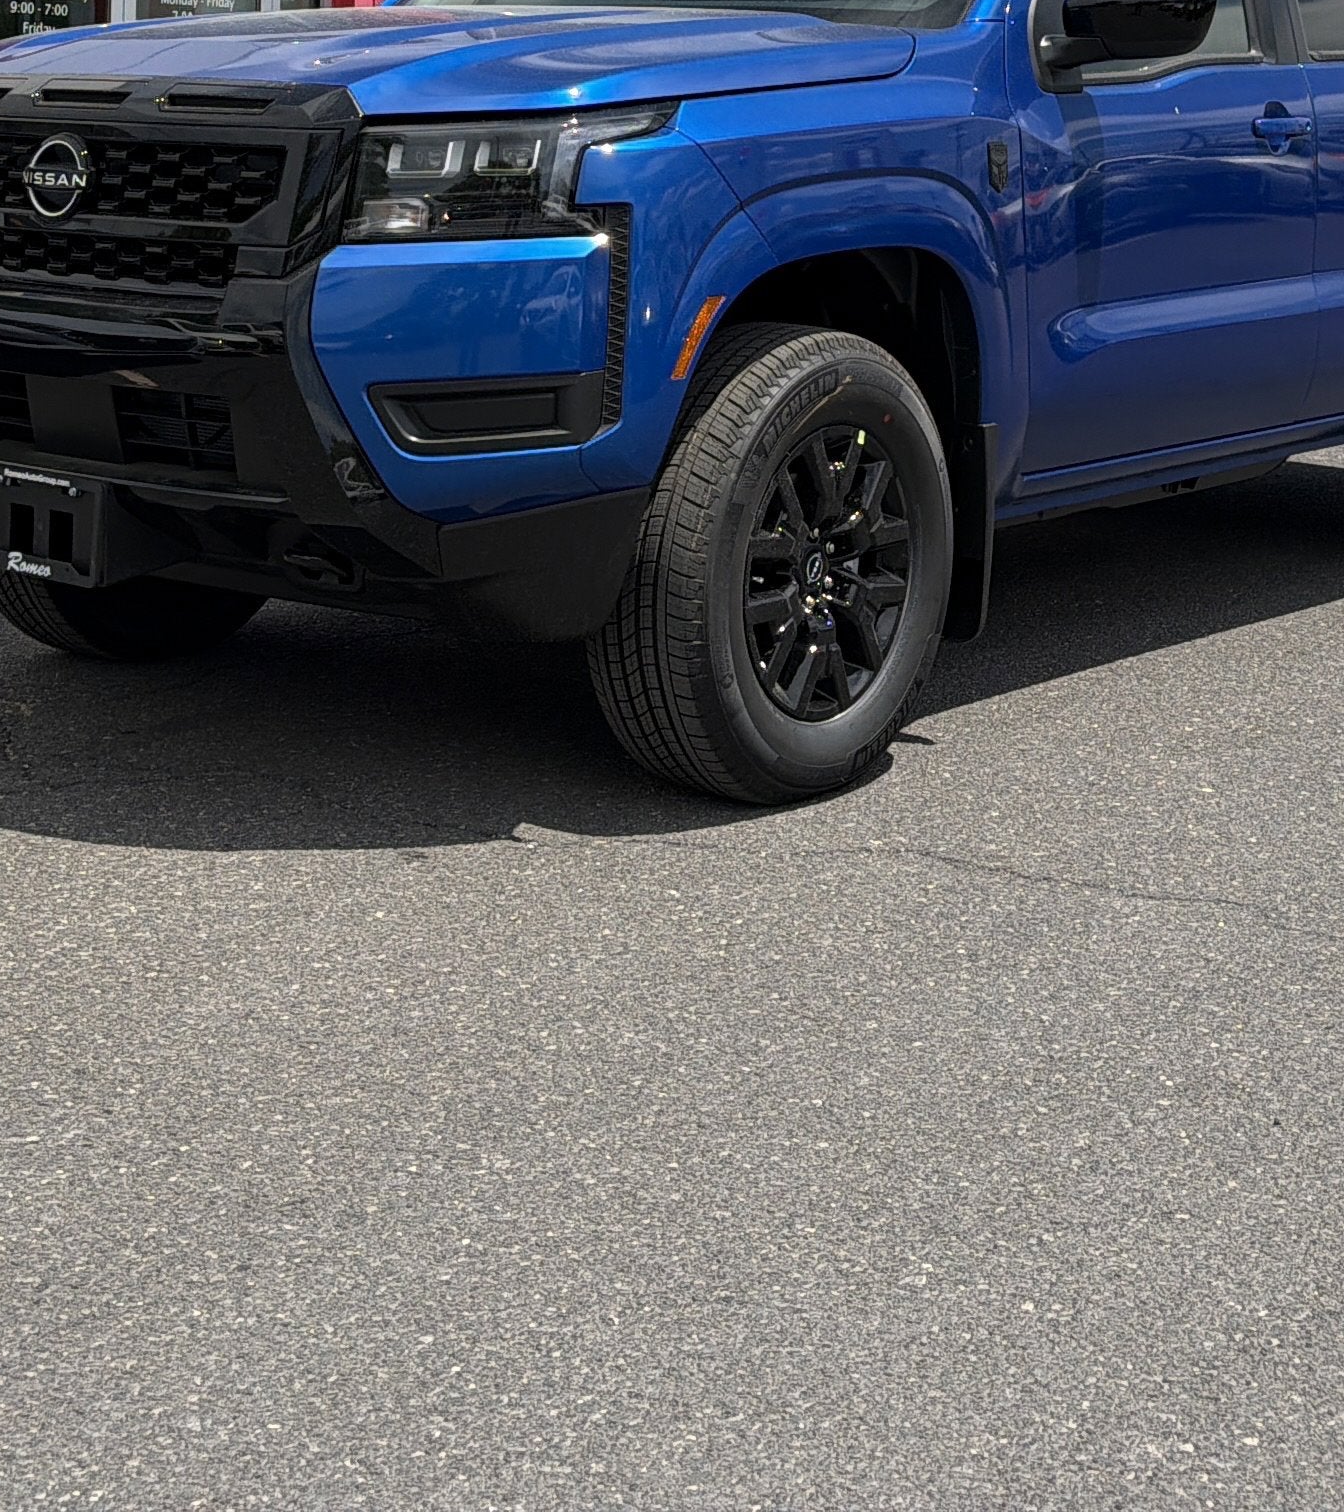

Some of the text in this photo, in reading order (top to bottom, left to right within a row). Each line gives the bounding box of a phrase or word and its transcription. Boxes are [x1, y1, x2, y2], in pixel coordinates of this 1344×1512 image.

[10, 1, 35, 15] 9:00
[45, 3, 69, 16] 7:00
[22, 171, 87, 187] NISSAN
[762, 372, 839, 456] MICHELIN
[7, 551, 52, 577] Romeo
